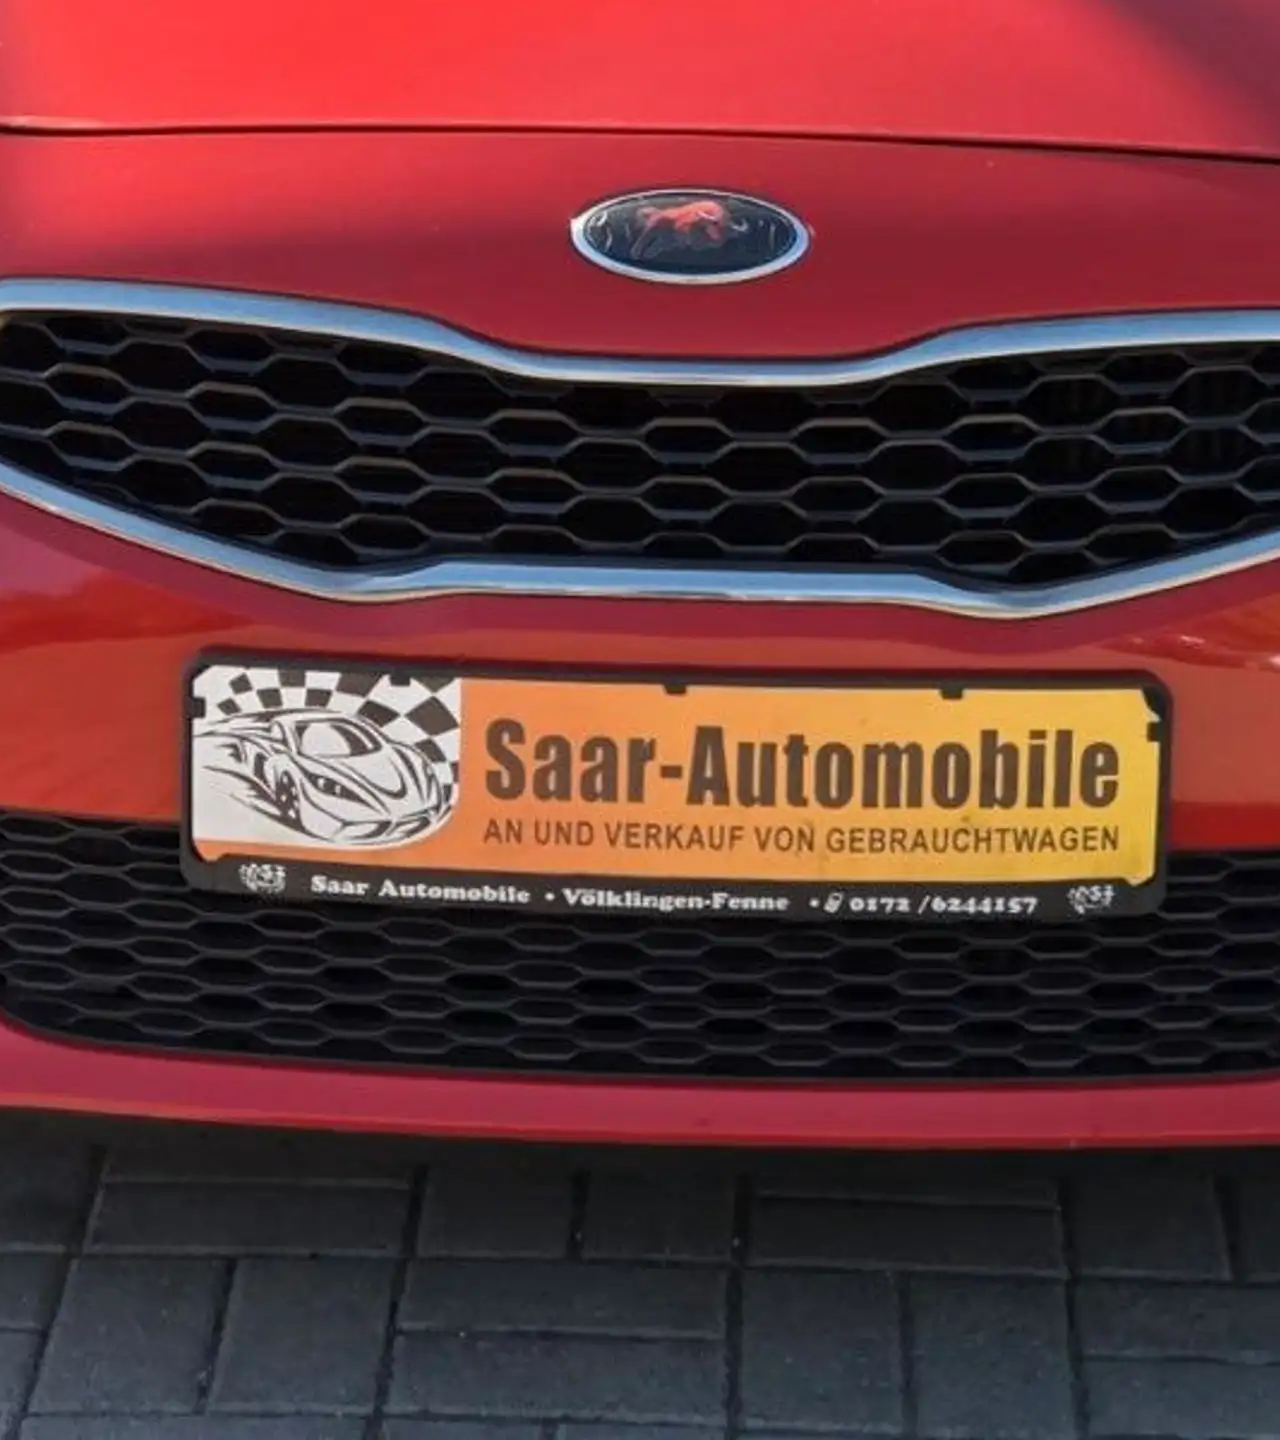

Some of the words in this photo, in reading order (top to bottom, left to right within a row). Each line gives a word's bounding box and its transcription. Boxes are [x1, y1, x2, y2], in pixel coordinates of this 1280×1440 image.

[485, 717, 1120, 810] Saar-Automobile
[483, 818, 523, 845] AN
[533, 819, 595, 847] UND
[604, 822, 745, 851] VERKAUF
[753, 825, 815, 853] VON
[825, 825, 1120, 854] GEBRAUCHTWAGEN
[310, 875, 370, 896] Saar
[378, 879, 531, 905] Automobile
[848, 896, 911, 913] 0172
